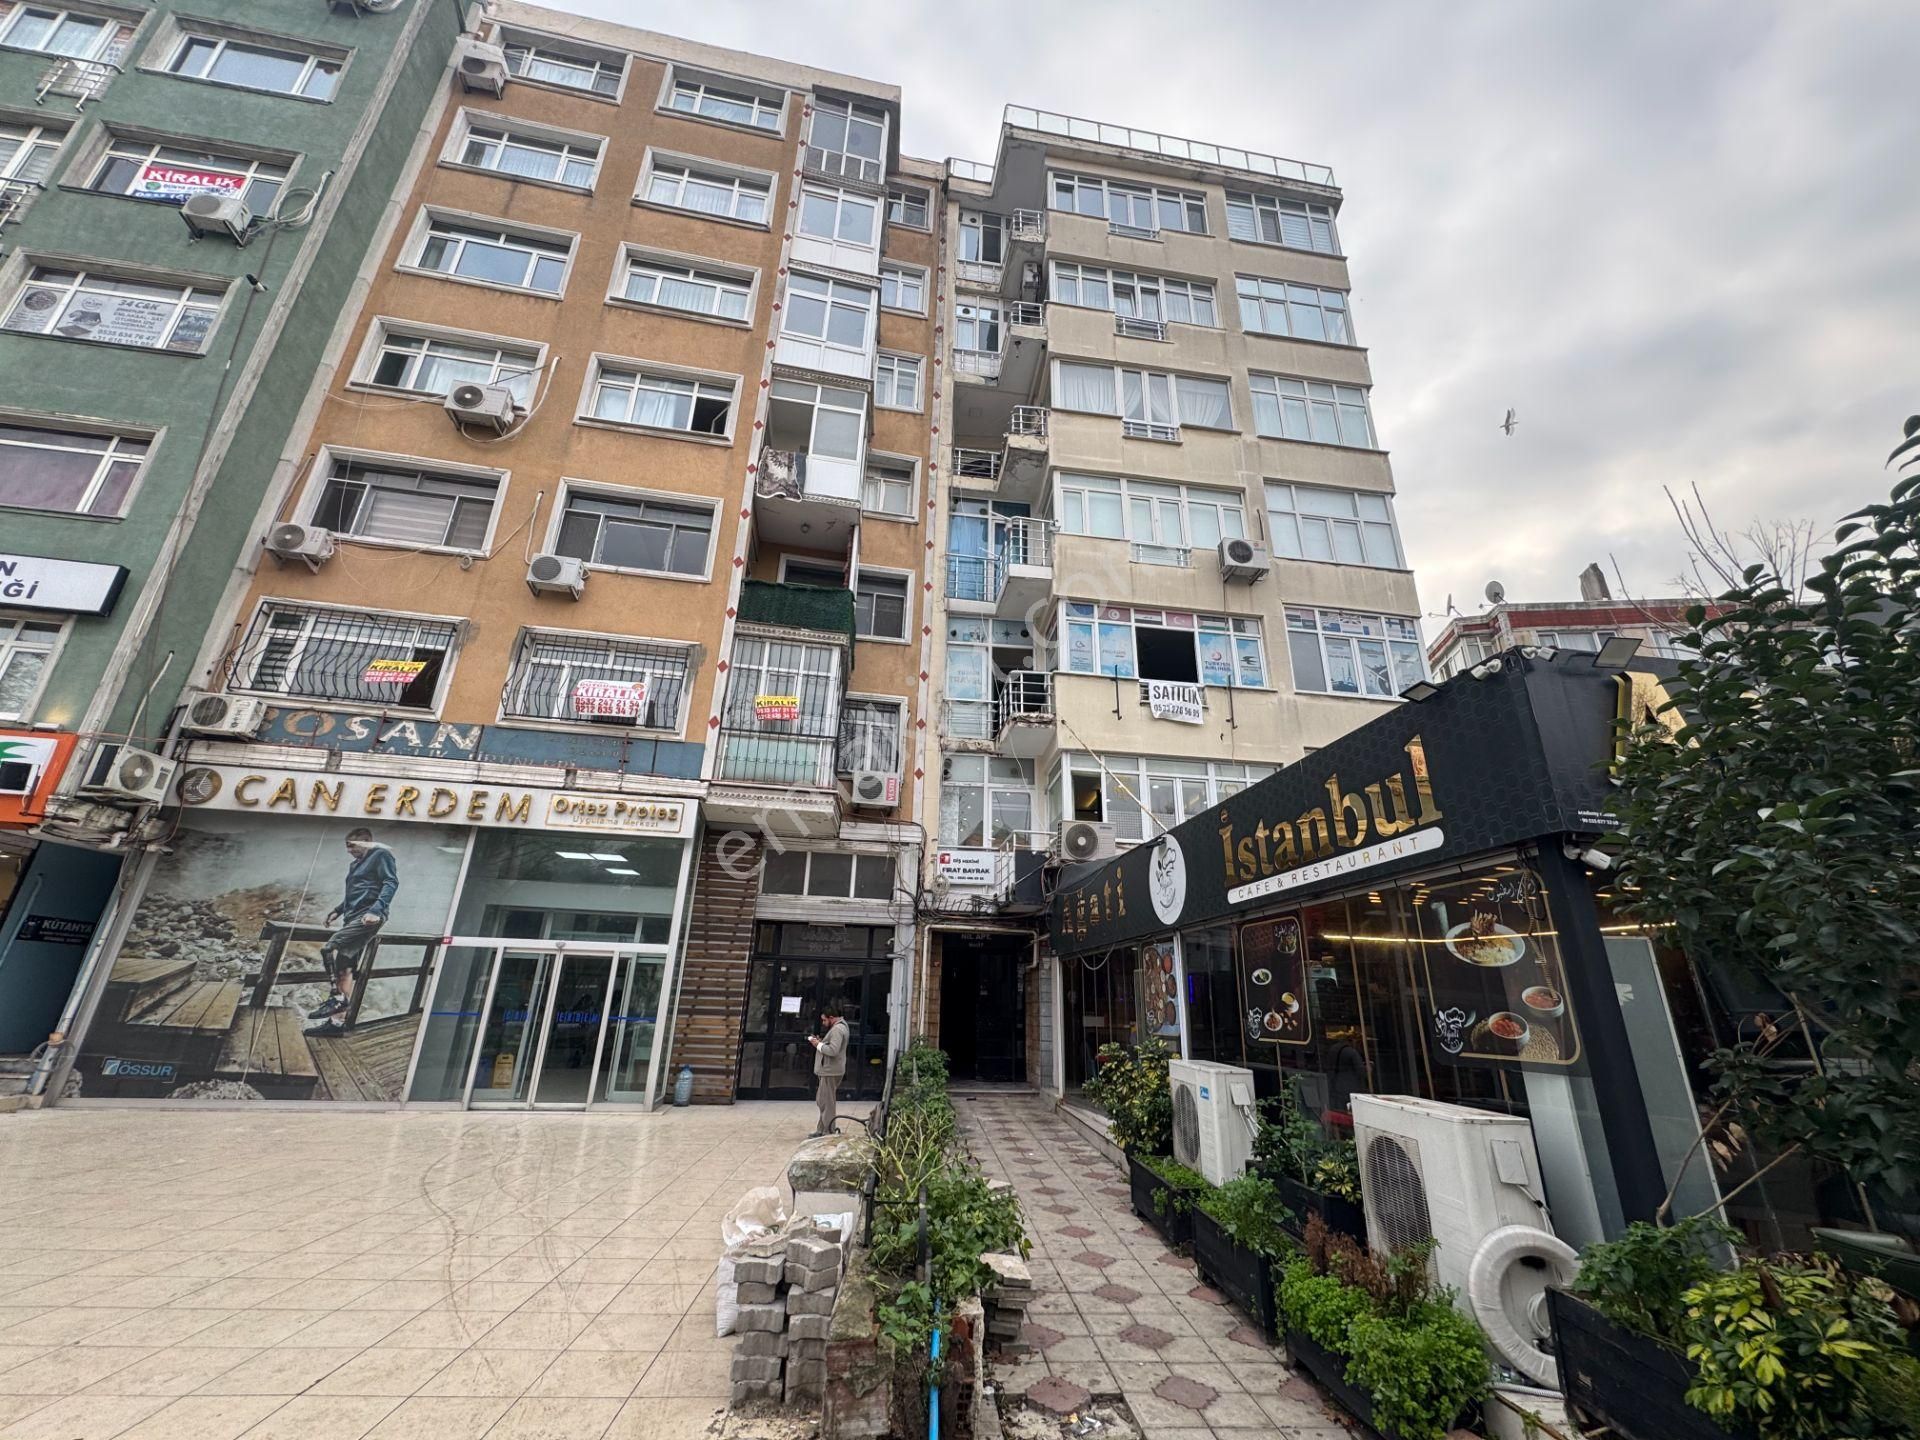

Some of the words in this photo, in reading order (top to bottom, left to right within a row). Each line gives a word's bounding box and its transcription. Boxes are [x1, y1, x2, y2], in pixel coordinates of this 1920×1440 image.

[147, 170, 239, 187] KİRALIK
[0, 578, 39, 599] Ğİ
[575, 697, 596, 706] 0532
[598, 698, 614, 706] 247
[616, 699, 626, 707] 21
[756, 700, 798, 708] KİRALIK
[1153, 685, 1200, 705] SATILIK
[575, 705, 596, 713] 0212
[234, 774, 344, 812] CAN
[363, 783, 532, 823] ERDEM
[553, 796, 609, 817] Ortez
[614, 800, 678, 821] Protez
[1218, 733, 1444, 890] İstanbul
[1238, 880, 1270, 899] CAFE
[1277, 877, 1285, 889] &
[1291, 836, 1419, 884] RESTAURANT
[118, 1061, 173, 1077] ÖSSUR
